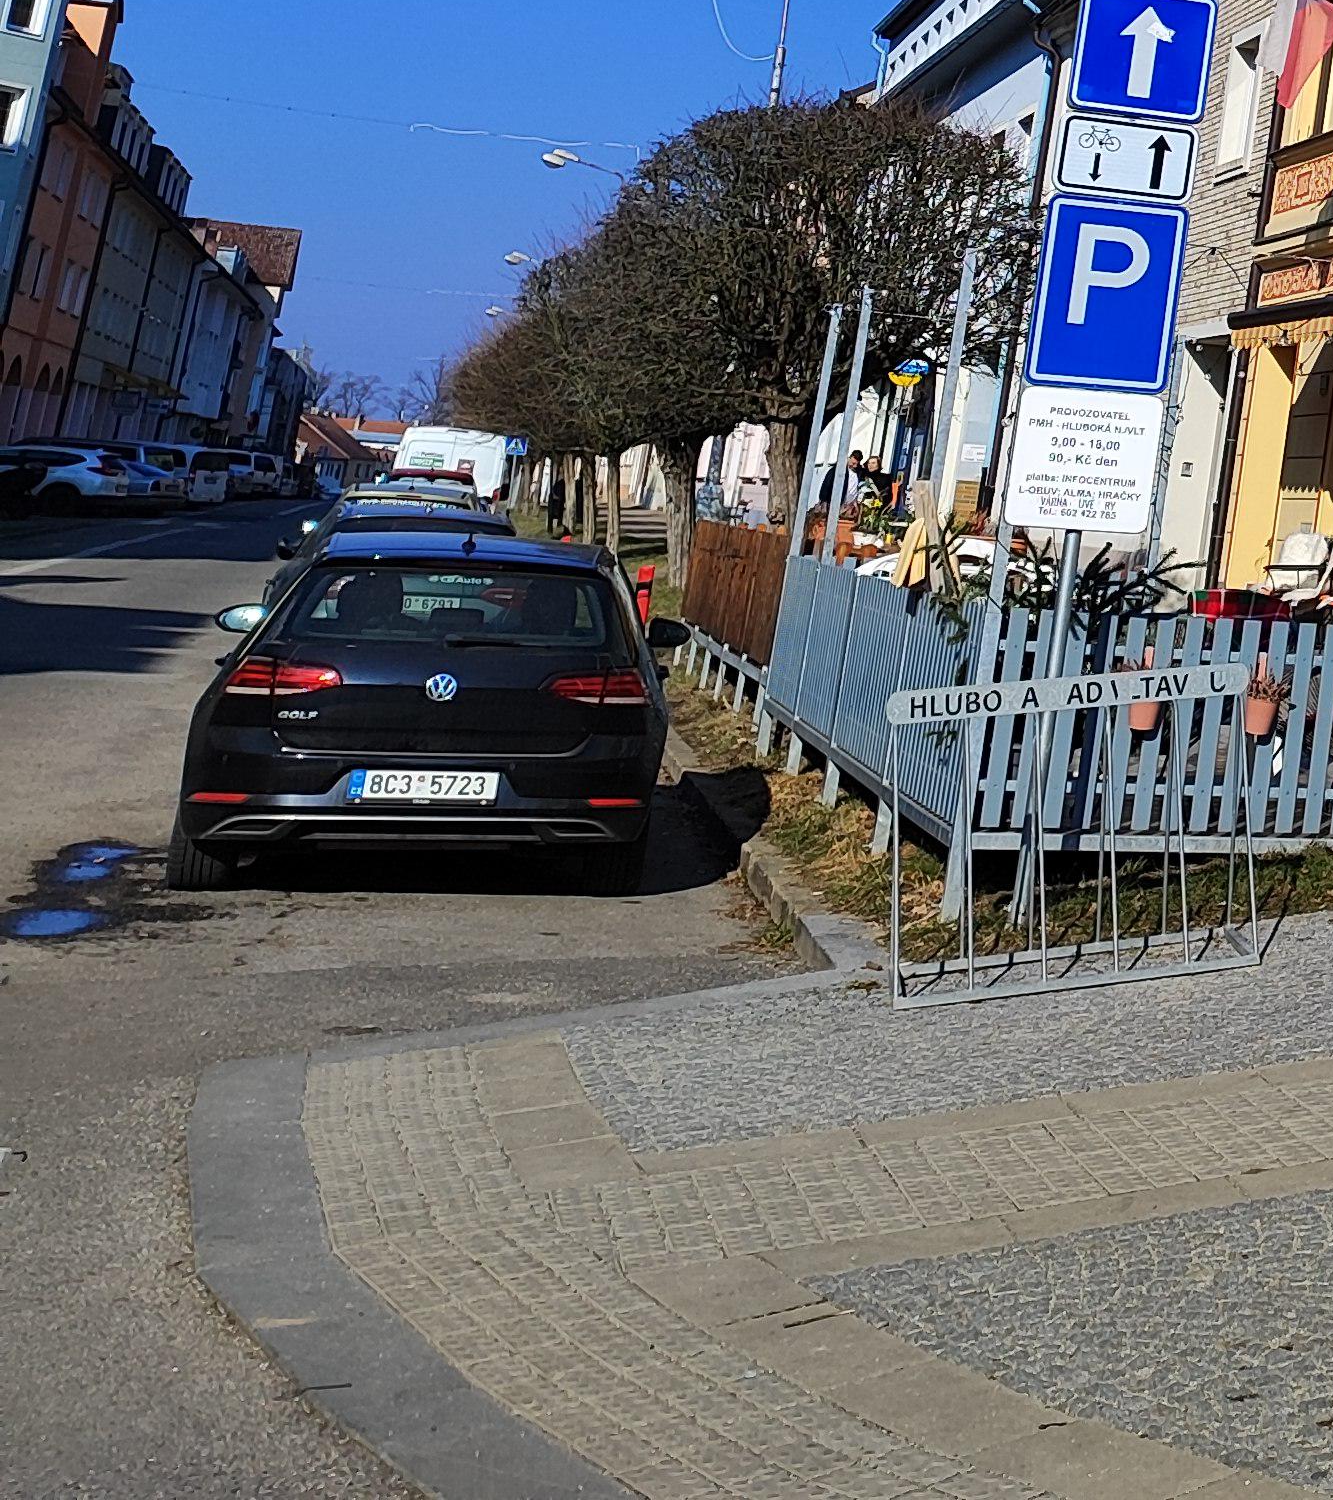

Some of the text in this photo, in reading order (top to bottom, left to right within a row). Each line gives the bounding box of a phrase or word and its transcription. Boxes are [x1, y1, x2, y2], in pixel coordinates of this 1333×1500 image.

[1066, 222, 1151, 326] P
[1049, 406, 1131, 421] PROVOZOVATEL
[1028, 418, 1054, 428] PMH
[1061, 421, 1112, 434] HLUBOKÁ
[1075, 454, 1092, 465] Kč
[1095, 456, 1118, 467] den
[1061, 474, 1136, 488] INFOCENTRUM
[277, 710, 319, 720] GOLF
[369, 773, 413, 795] 8C3
[429, 774, 487, 796] 5723
